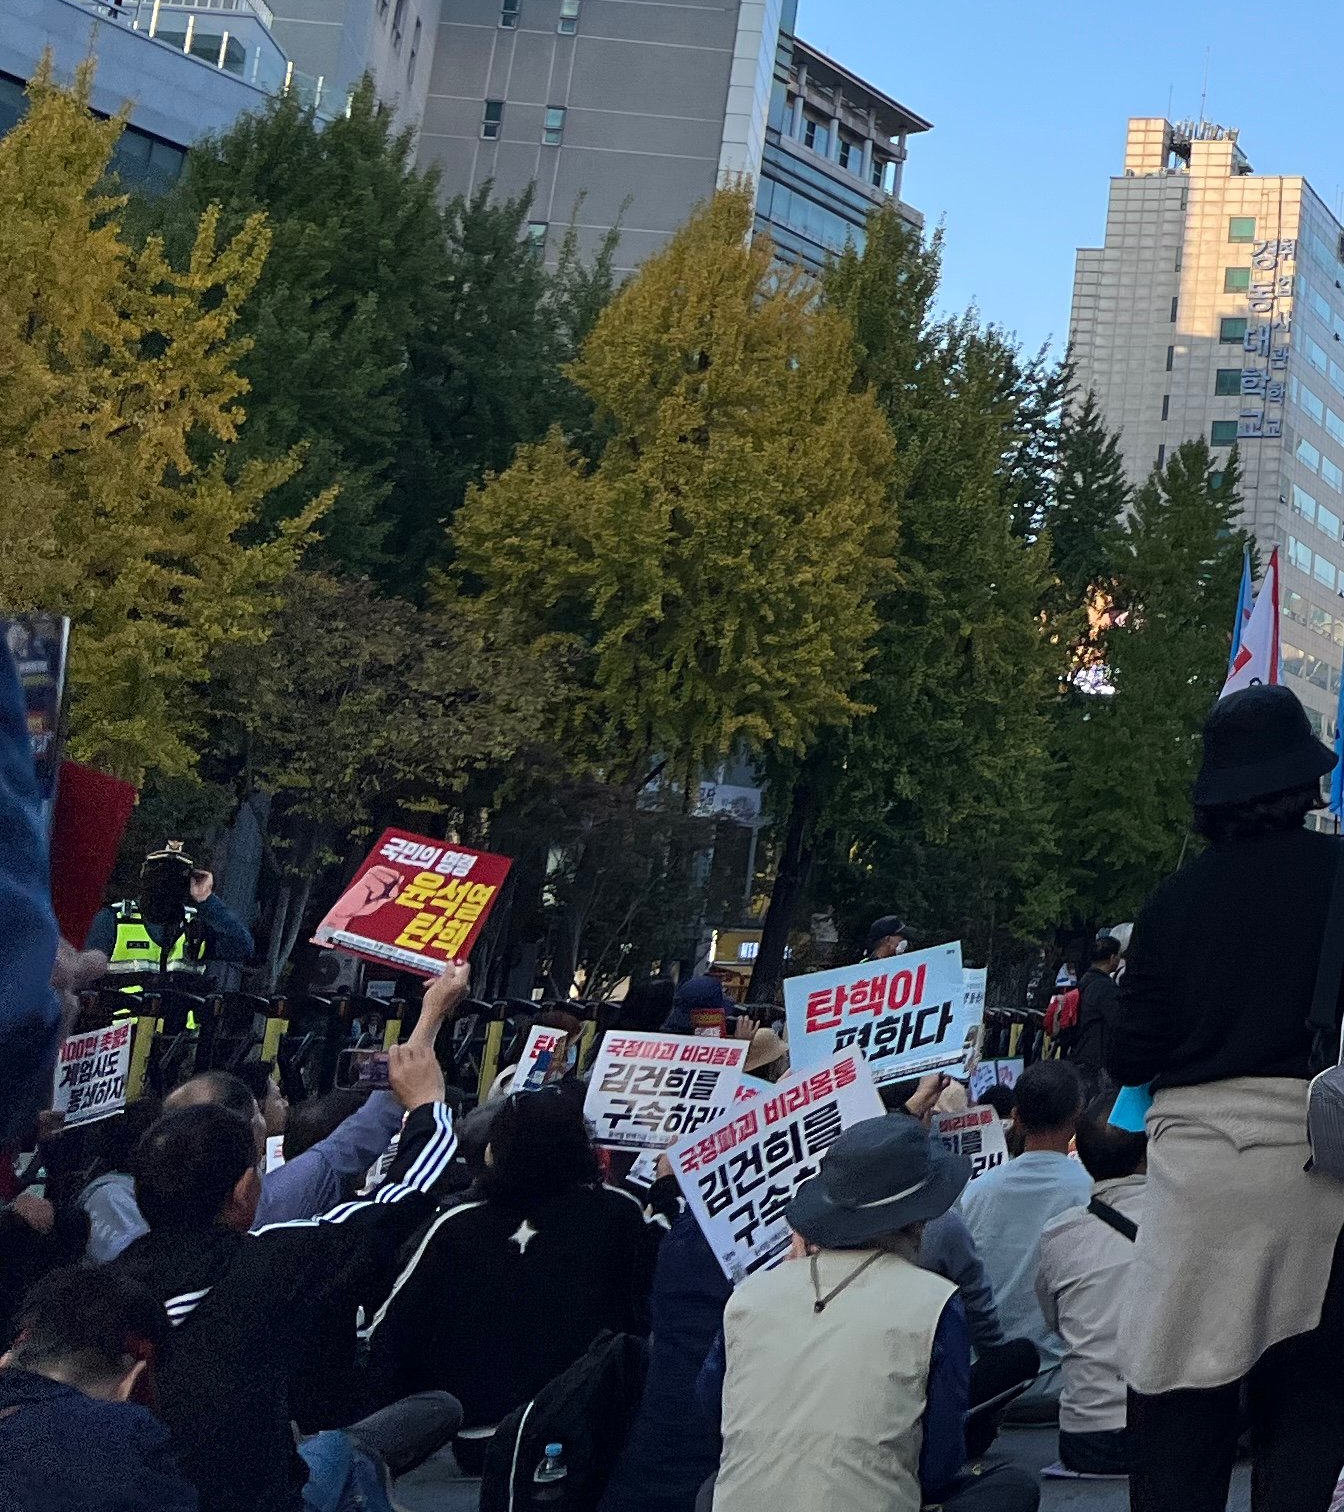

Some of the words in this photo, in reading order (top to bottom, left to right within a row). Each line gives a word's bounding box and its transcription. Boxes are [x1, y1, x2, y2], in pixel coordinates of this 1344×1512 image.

[1237, 239, 1279, 438] 경동대학교
[379, 837, 443, 870] 국민의
[394, 871, 497, 922] 윤석열
[394, 911, 474, 959] 탄핵
[806, 963, 928, 1034] 탄핵이
[606, 1038, 679, 1061] 국정파괴
[598, 1063, 721, 1101] 김건희를
[679, 1108, 759, 1175] 국정파괴
[698, 1099, 842, 1219] 김건희를
